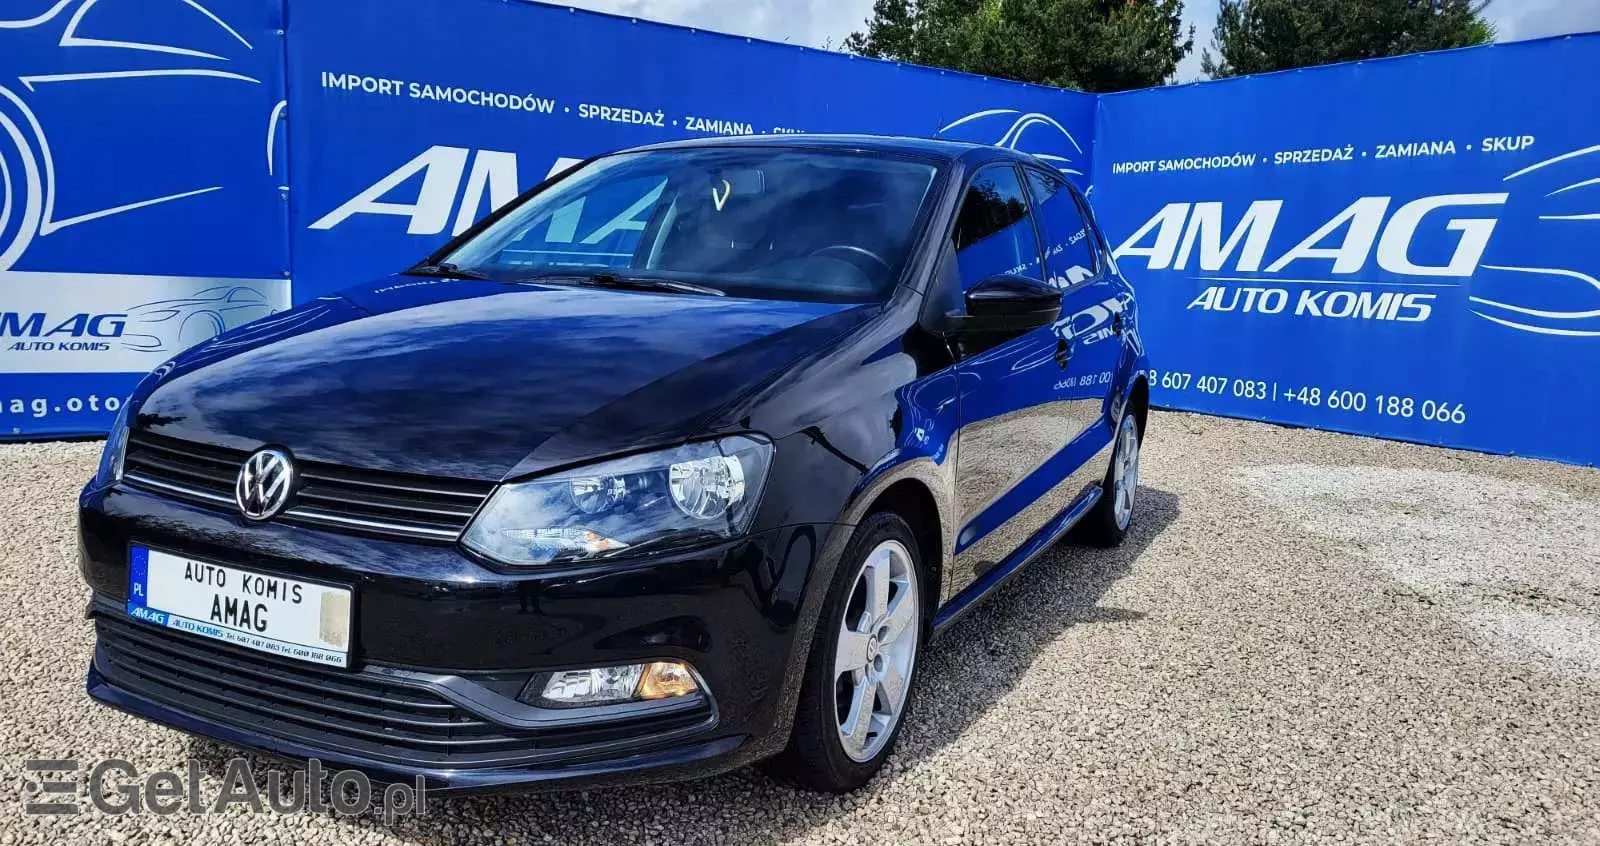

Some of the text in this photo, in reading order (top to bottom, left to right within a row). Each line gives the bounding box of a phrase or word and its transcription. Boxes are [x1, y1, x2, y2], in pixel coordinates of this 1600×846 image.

[321, 71, 754, 135] IMPORT SAMOCHODÓW SPRZEDAŻ ZAMIANA
[1112, 135, 1534, 175] IMPORT SAMOCHODÓW SPRZEDAŻ ZAMIANA SKUP
[1112, 192, 1509, 277] AMAG
[1187, 286, 1436, 322] AUTO KOMIS
[0, 312, 128, 337] MAG
[8, 342, 111, 351] AUTO KOMIS
[1162, 371, 1191, 390] 607
[1197, 375, 1228, 395] 407
[1233, 379, 1266, 399] 083
[1283, 386, 1321, 407] +48
[1327, 390, 1366, 412] 600
[1376, 394, 1414, 417] 188
[1421, 400, 1466, 424] 066
[133, 583, 144, 597] PL
[185, 561, 303, 604] AUTO KOMIS
[131, 607, 166, 624] AMAG
[210, 594, 268, 632] AMAG
